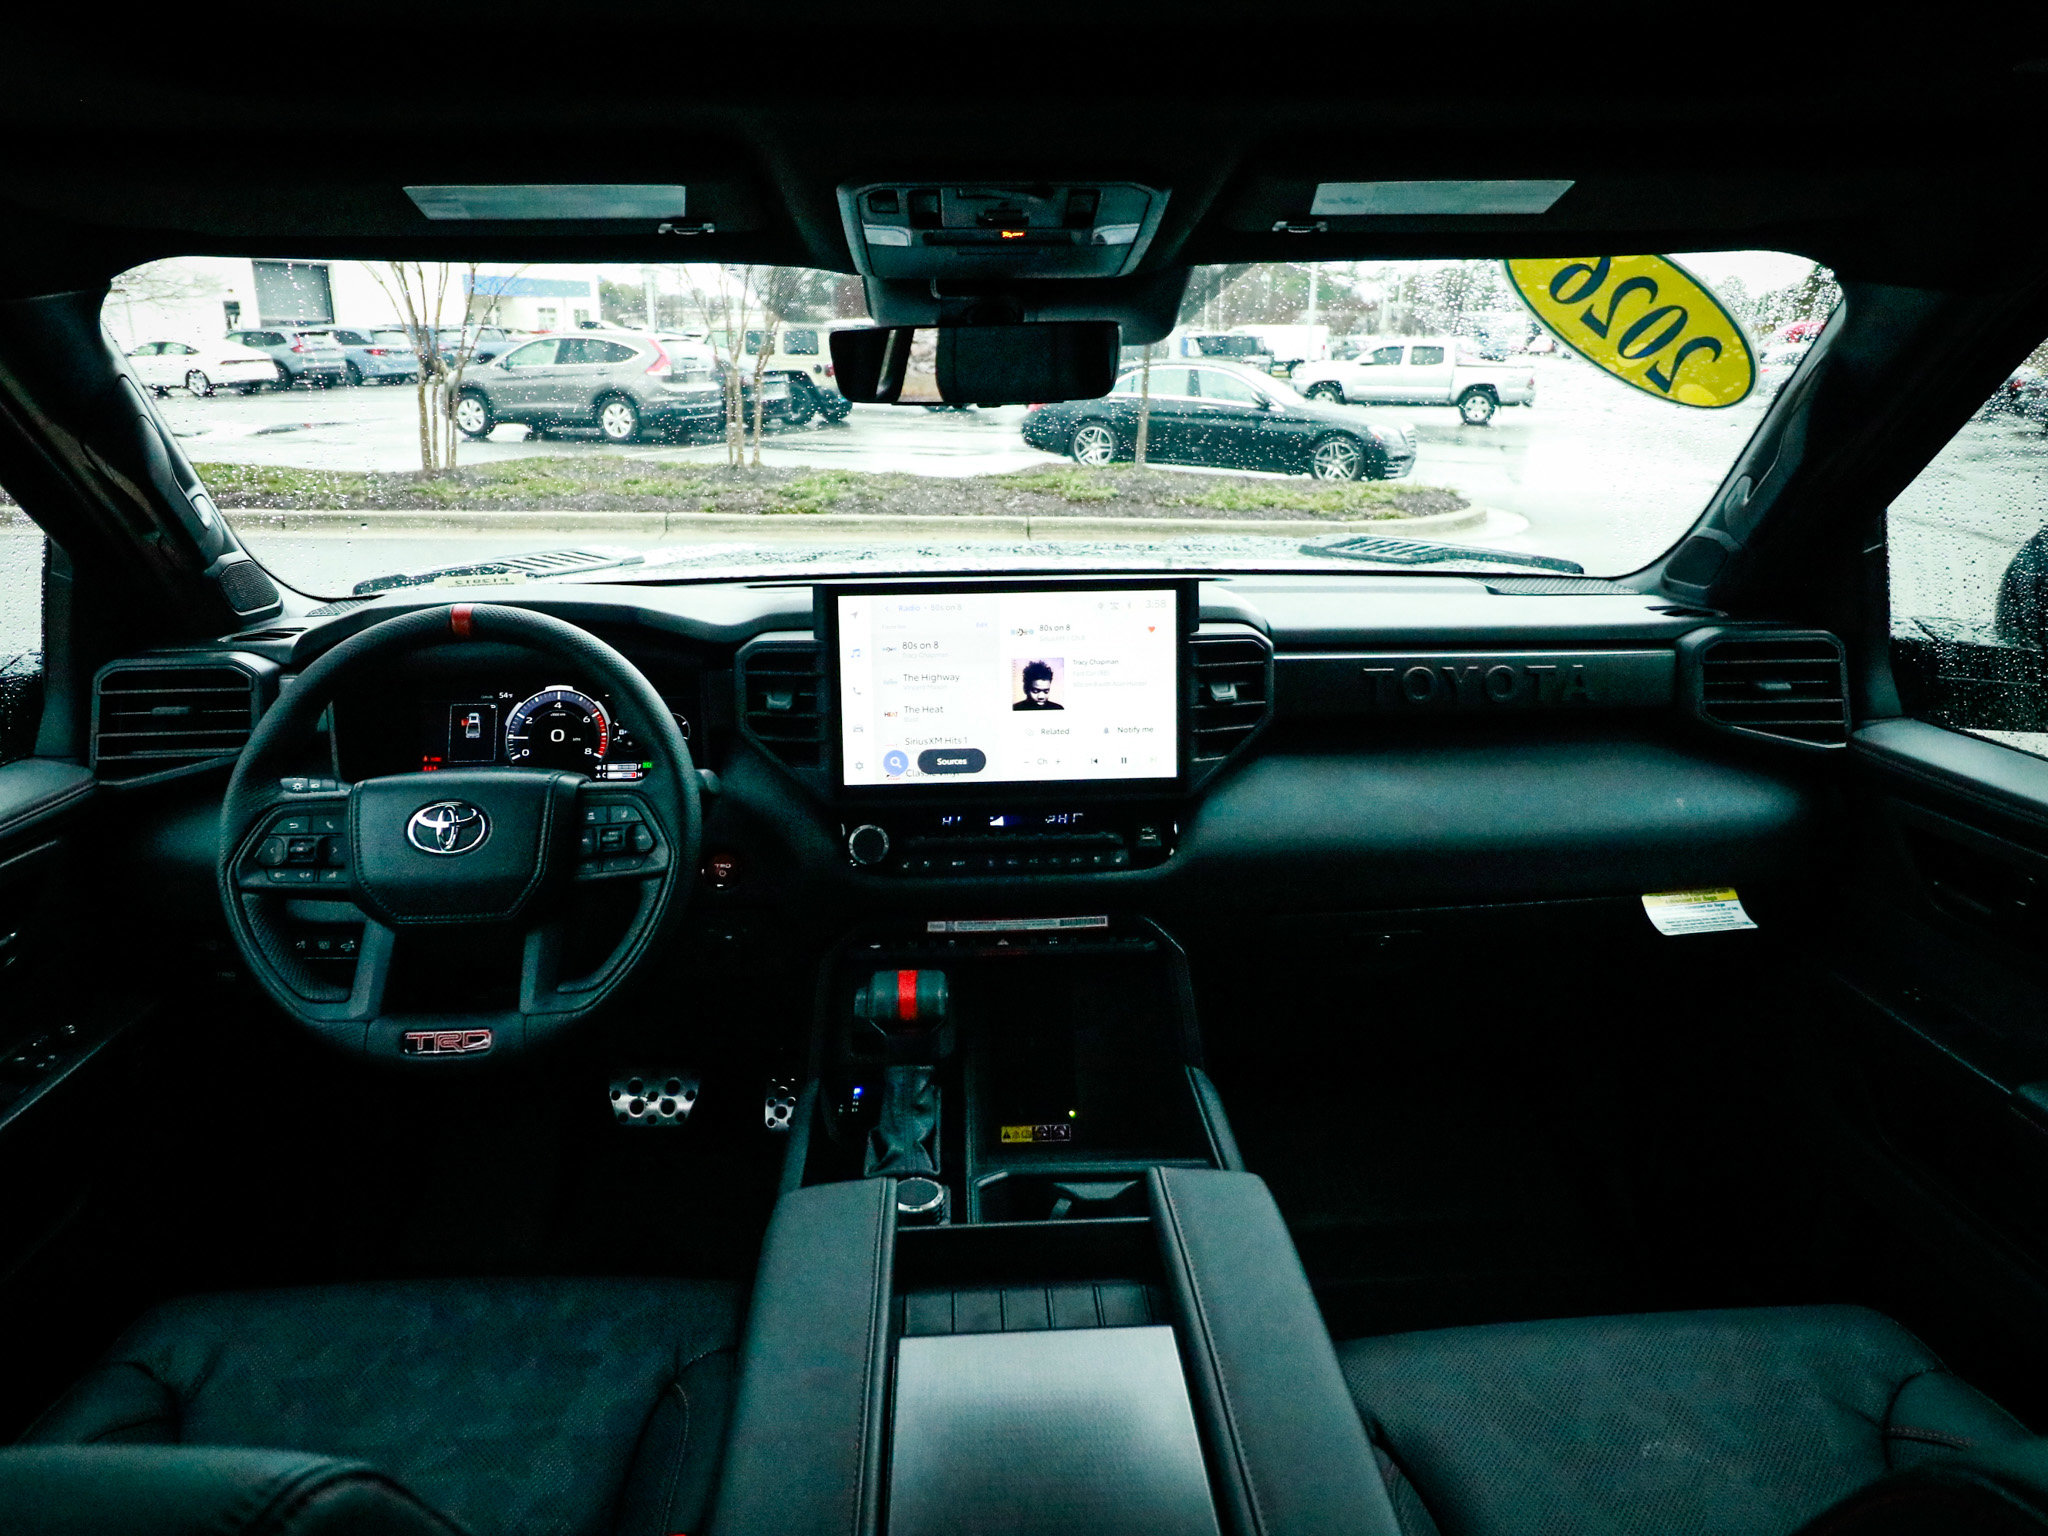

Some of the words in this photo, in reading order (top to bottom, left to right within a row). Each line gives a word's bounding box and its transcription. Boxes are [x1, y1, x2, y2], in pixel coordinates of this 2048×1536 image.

[898, 604, 921, 612] Radio
[1145, 600, 1167, 609] 3:58
[1066, 624, 1071, 632] 8
[902, 640, 918, 650] 80s
[920, 642, 931, 650] on
[933, 640, 939, 650] 8
[1073, 659, 1088, 667] Tracy
[1089, 658, 1119, 667] Chapman
[903, 673, 919, 682] The
[921, 672, 960, 684] Highway
[1362, 664, 1590, 701] TOYOTA
[904, 706, 920, 715] The
[922, 705, 945, 714] Heat
[525, 716, 533, 725] 2
[582, 715, 591, 724] 6
[550, 728, 565, 743] 0
[1041, 728, 1070, 736] Related
[1117, 726, 1140, 736] Notify
[905, 737, 943, 746] SiriusXM
[945, 737, 961, 745] Hits
[521, 748, 530, 757] 0
[584, 747, 592, 755] 8
[936, 757, 968, 766] Sources
[1037, 758, 1048, 766] Ch
[405, 1029, 492, 1054] TRD
